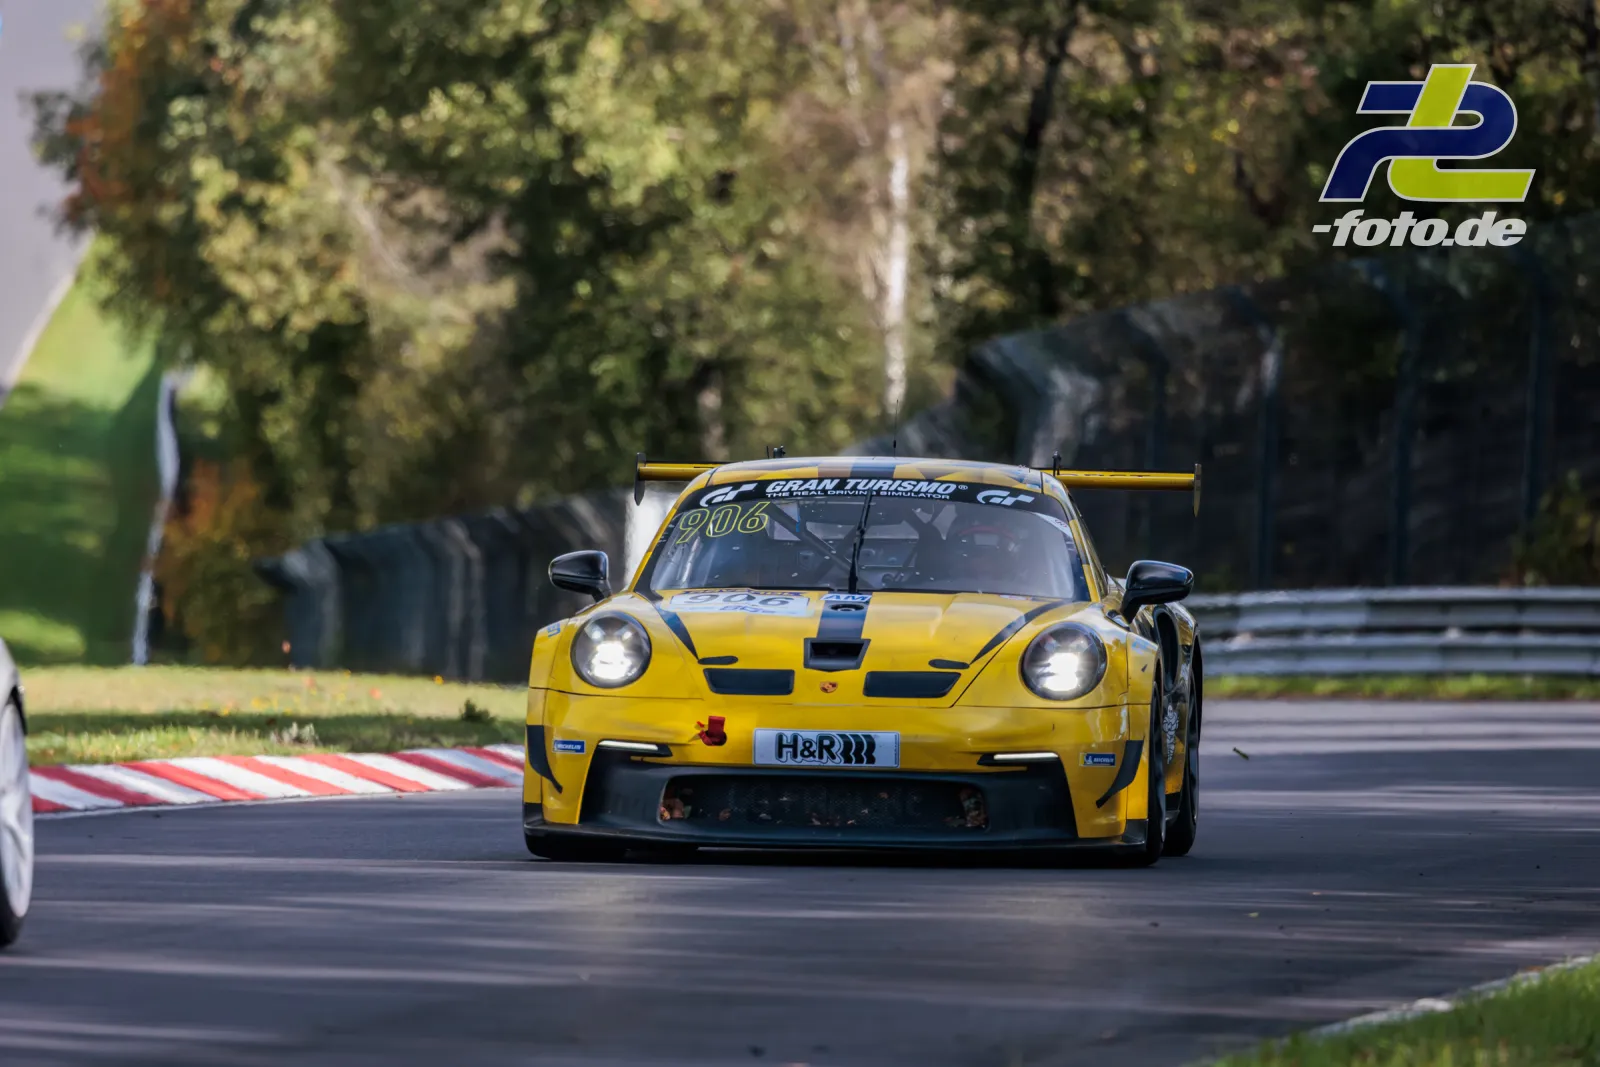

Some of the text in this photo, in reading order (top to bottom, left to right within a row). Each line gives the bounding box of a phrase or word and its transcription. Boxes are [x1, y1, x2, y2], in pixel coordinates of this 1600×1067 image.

[765, 479, 841, 493] GRAN
[879, 490, 950, 500] SIMULATOR
[676, 502, 771, 545] 906
[684, 594, 794, 606] 906
[825, 594, 869, 602] AM
[774, 732, 842, 763] H&R
